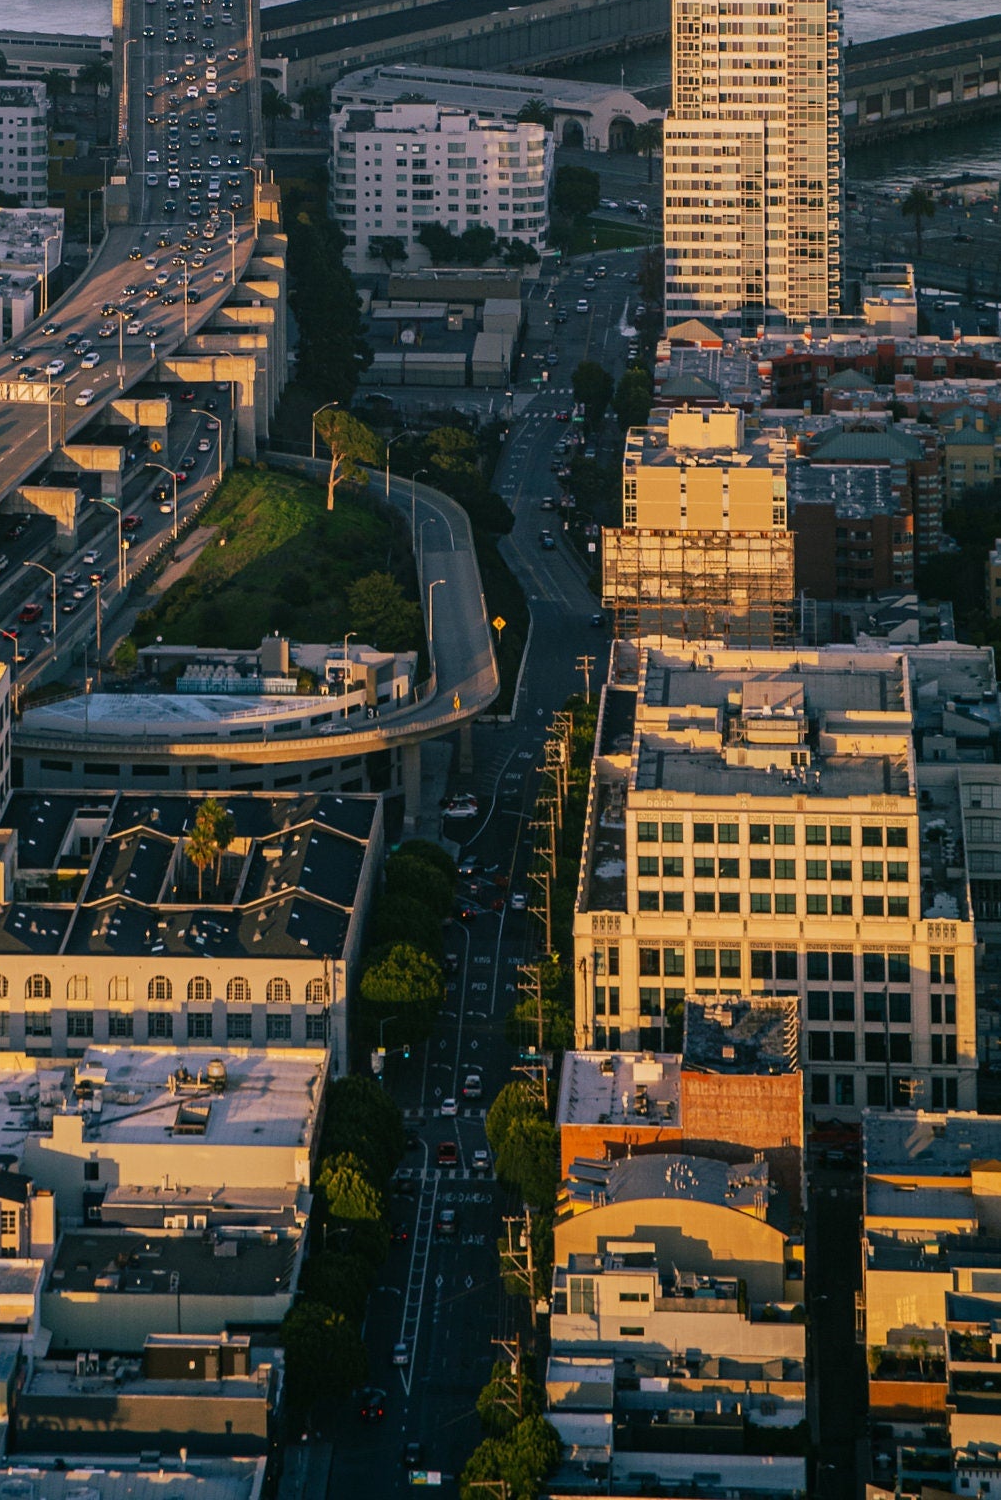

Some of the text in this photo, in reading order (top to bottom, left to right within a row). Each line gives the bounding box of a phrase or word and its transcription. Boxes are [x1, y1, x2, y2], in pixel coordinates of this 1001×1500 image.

[473, 955, 491, 965] XING
[471, 982, 488, 991] PED
[461, 1233, 486, 1245] LANE
